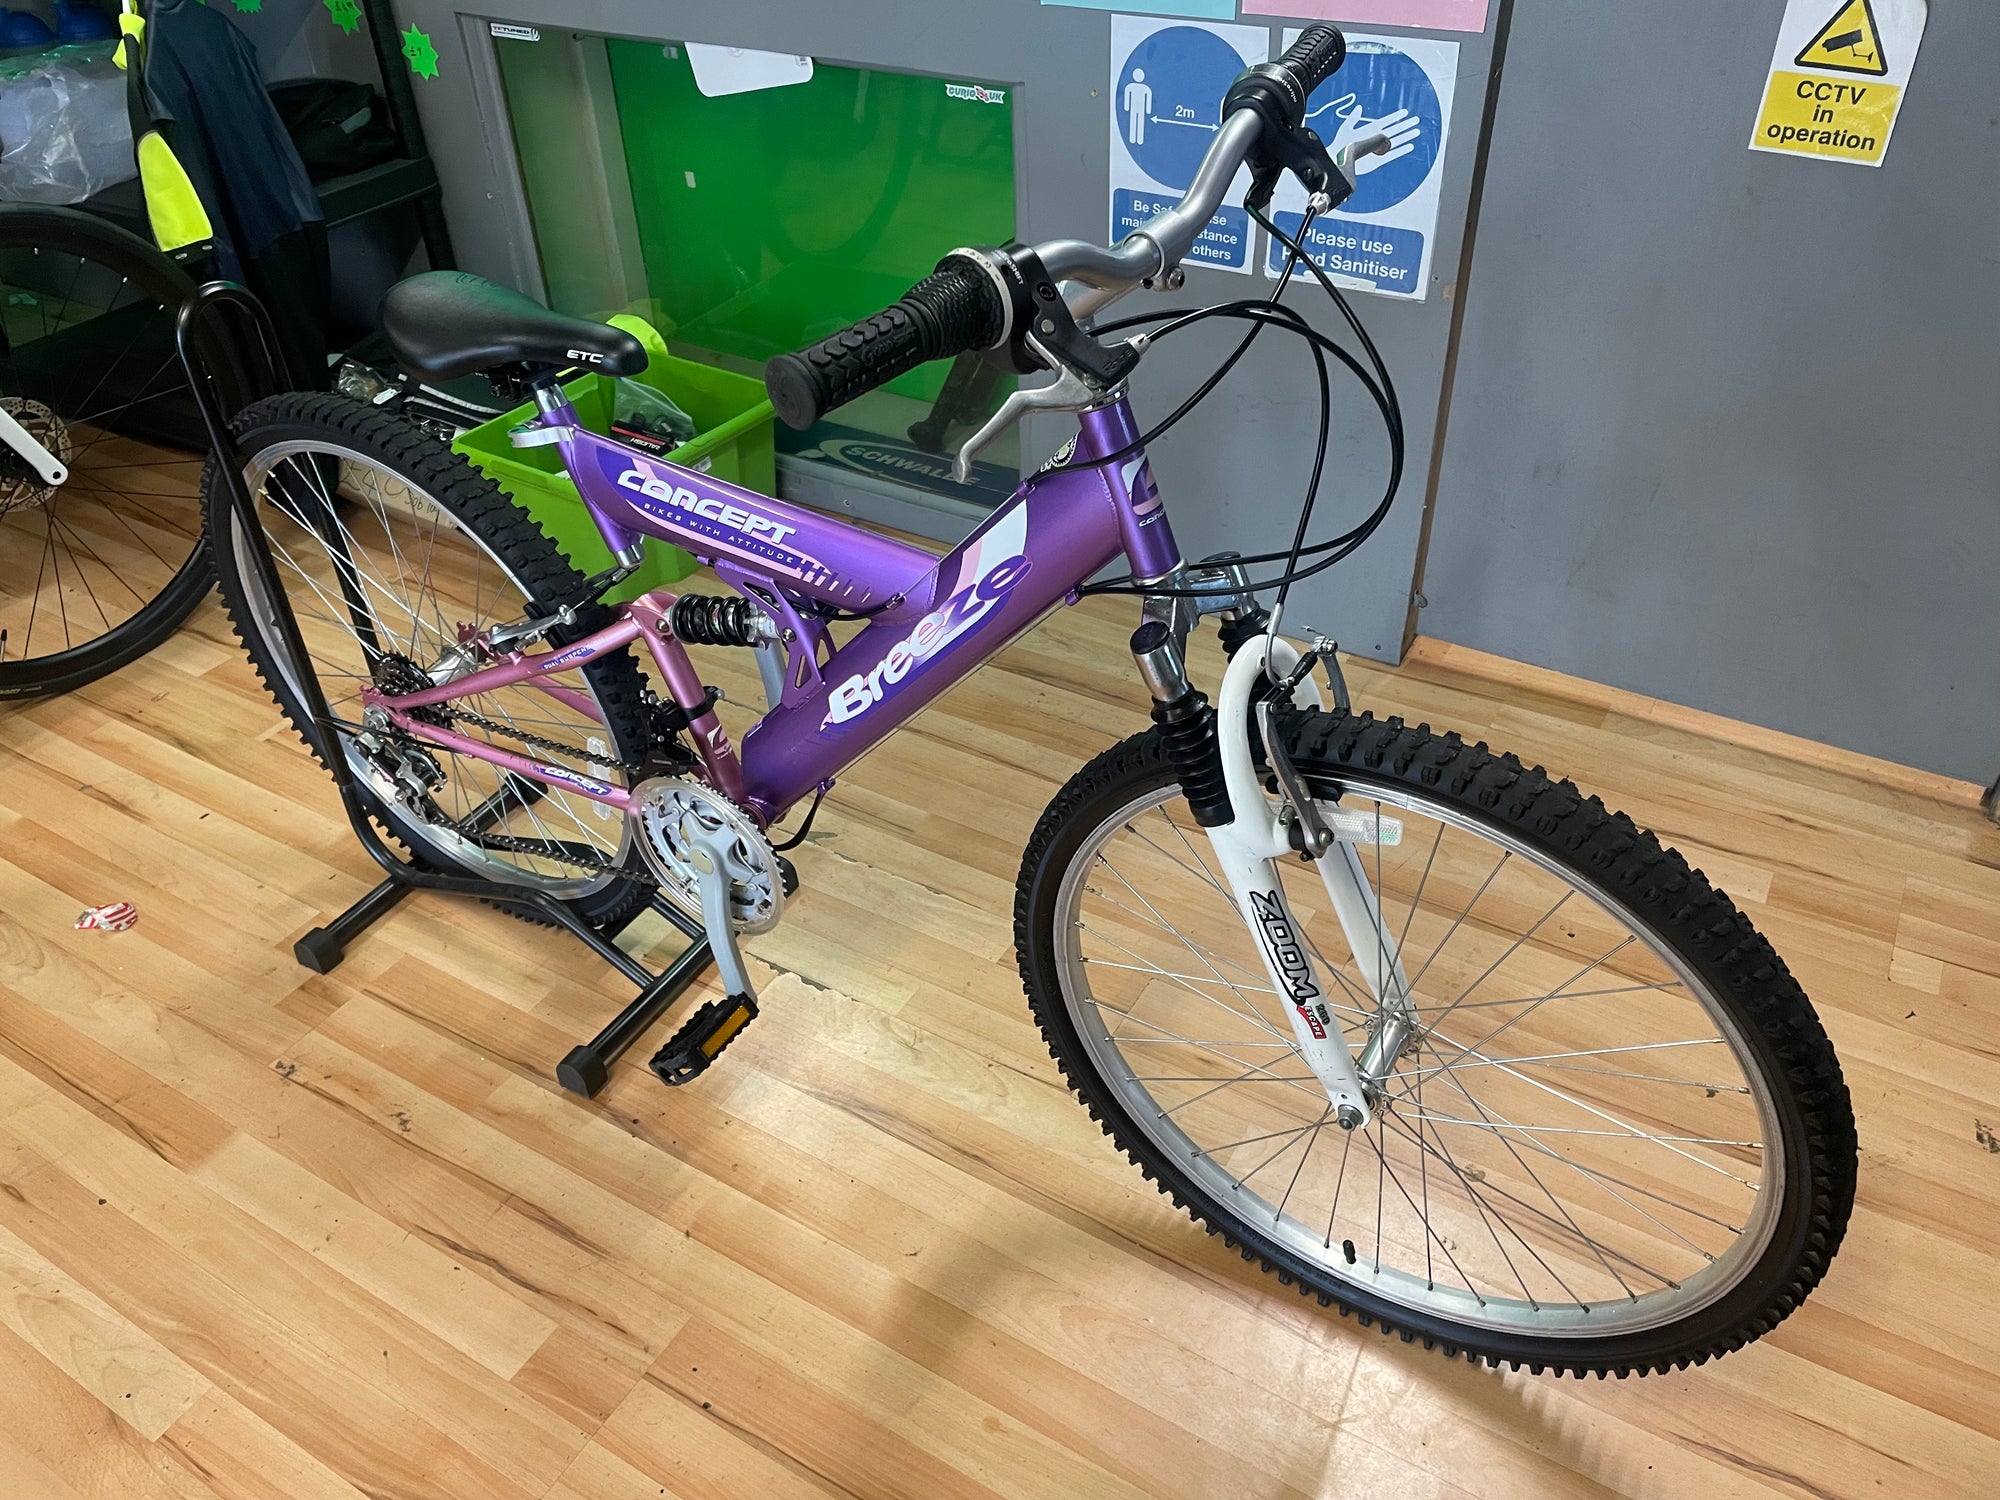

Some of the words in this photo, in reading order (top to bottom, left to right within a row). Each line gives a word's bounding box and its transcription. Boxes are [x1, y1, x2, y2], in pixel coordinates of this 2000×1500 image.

[948, 86, 976, 98] CURIO
[989, 92, 1002, 102] UK
[1796, 80, 1867, 106] CCTV
[1175, 104, 1195, 119] 2m
[1812, 104, 1834, 124] in
[1767, 124, 1875, 151] operation
[1133, 199, 1150, 214] Be
[1152, 202, 1176, 216] Saf
[1197, 228, 1238, 245] stance
[1361, 238, 1394, 256] use
[1192, 245, 1232, 261] others
[1330, 253, 1408, 281] Sanitiser
[566, 348, 605, 364] ETC
[845, 446, 981, 487] SCHWALE
[616, 469, 797, 545] CONCEPT
[643, 502, 683, 522] BIKES
[688, 519, 721, 537] WITH
[727, 534, 795, 564] ATTITUDE
[828, 554, 1033, 724] Breeze
[544, 766, 608, 795] CONCEPT
[1249, 889, 1320, 999] ZOOM
[1304, 1004, 1324, 1037] ESCAPE
